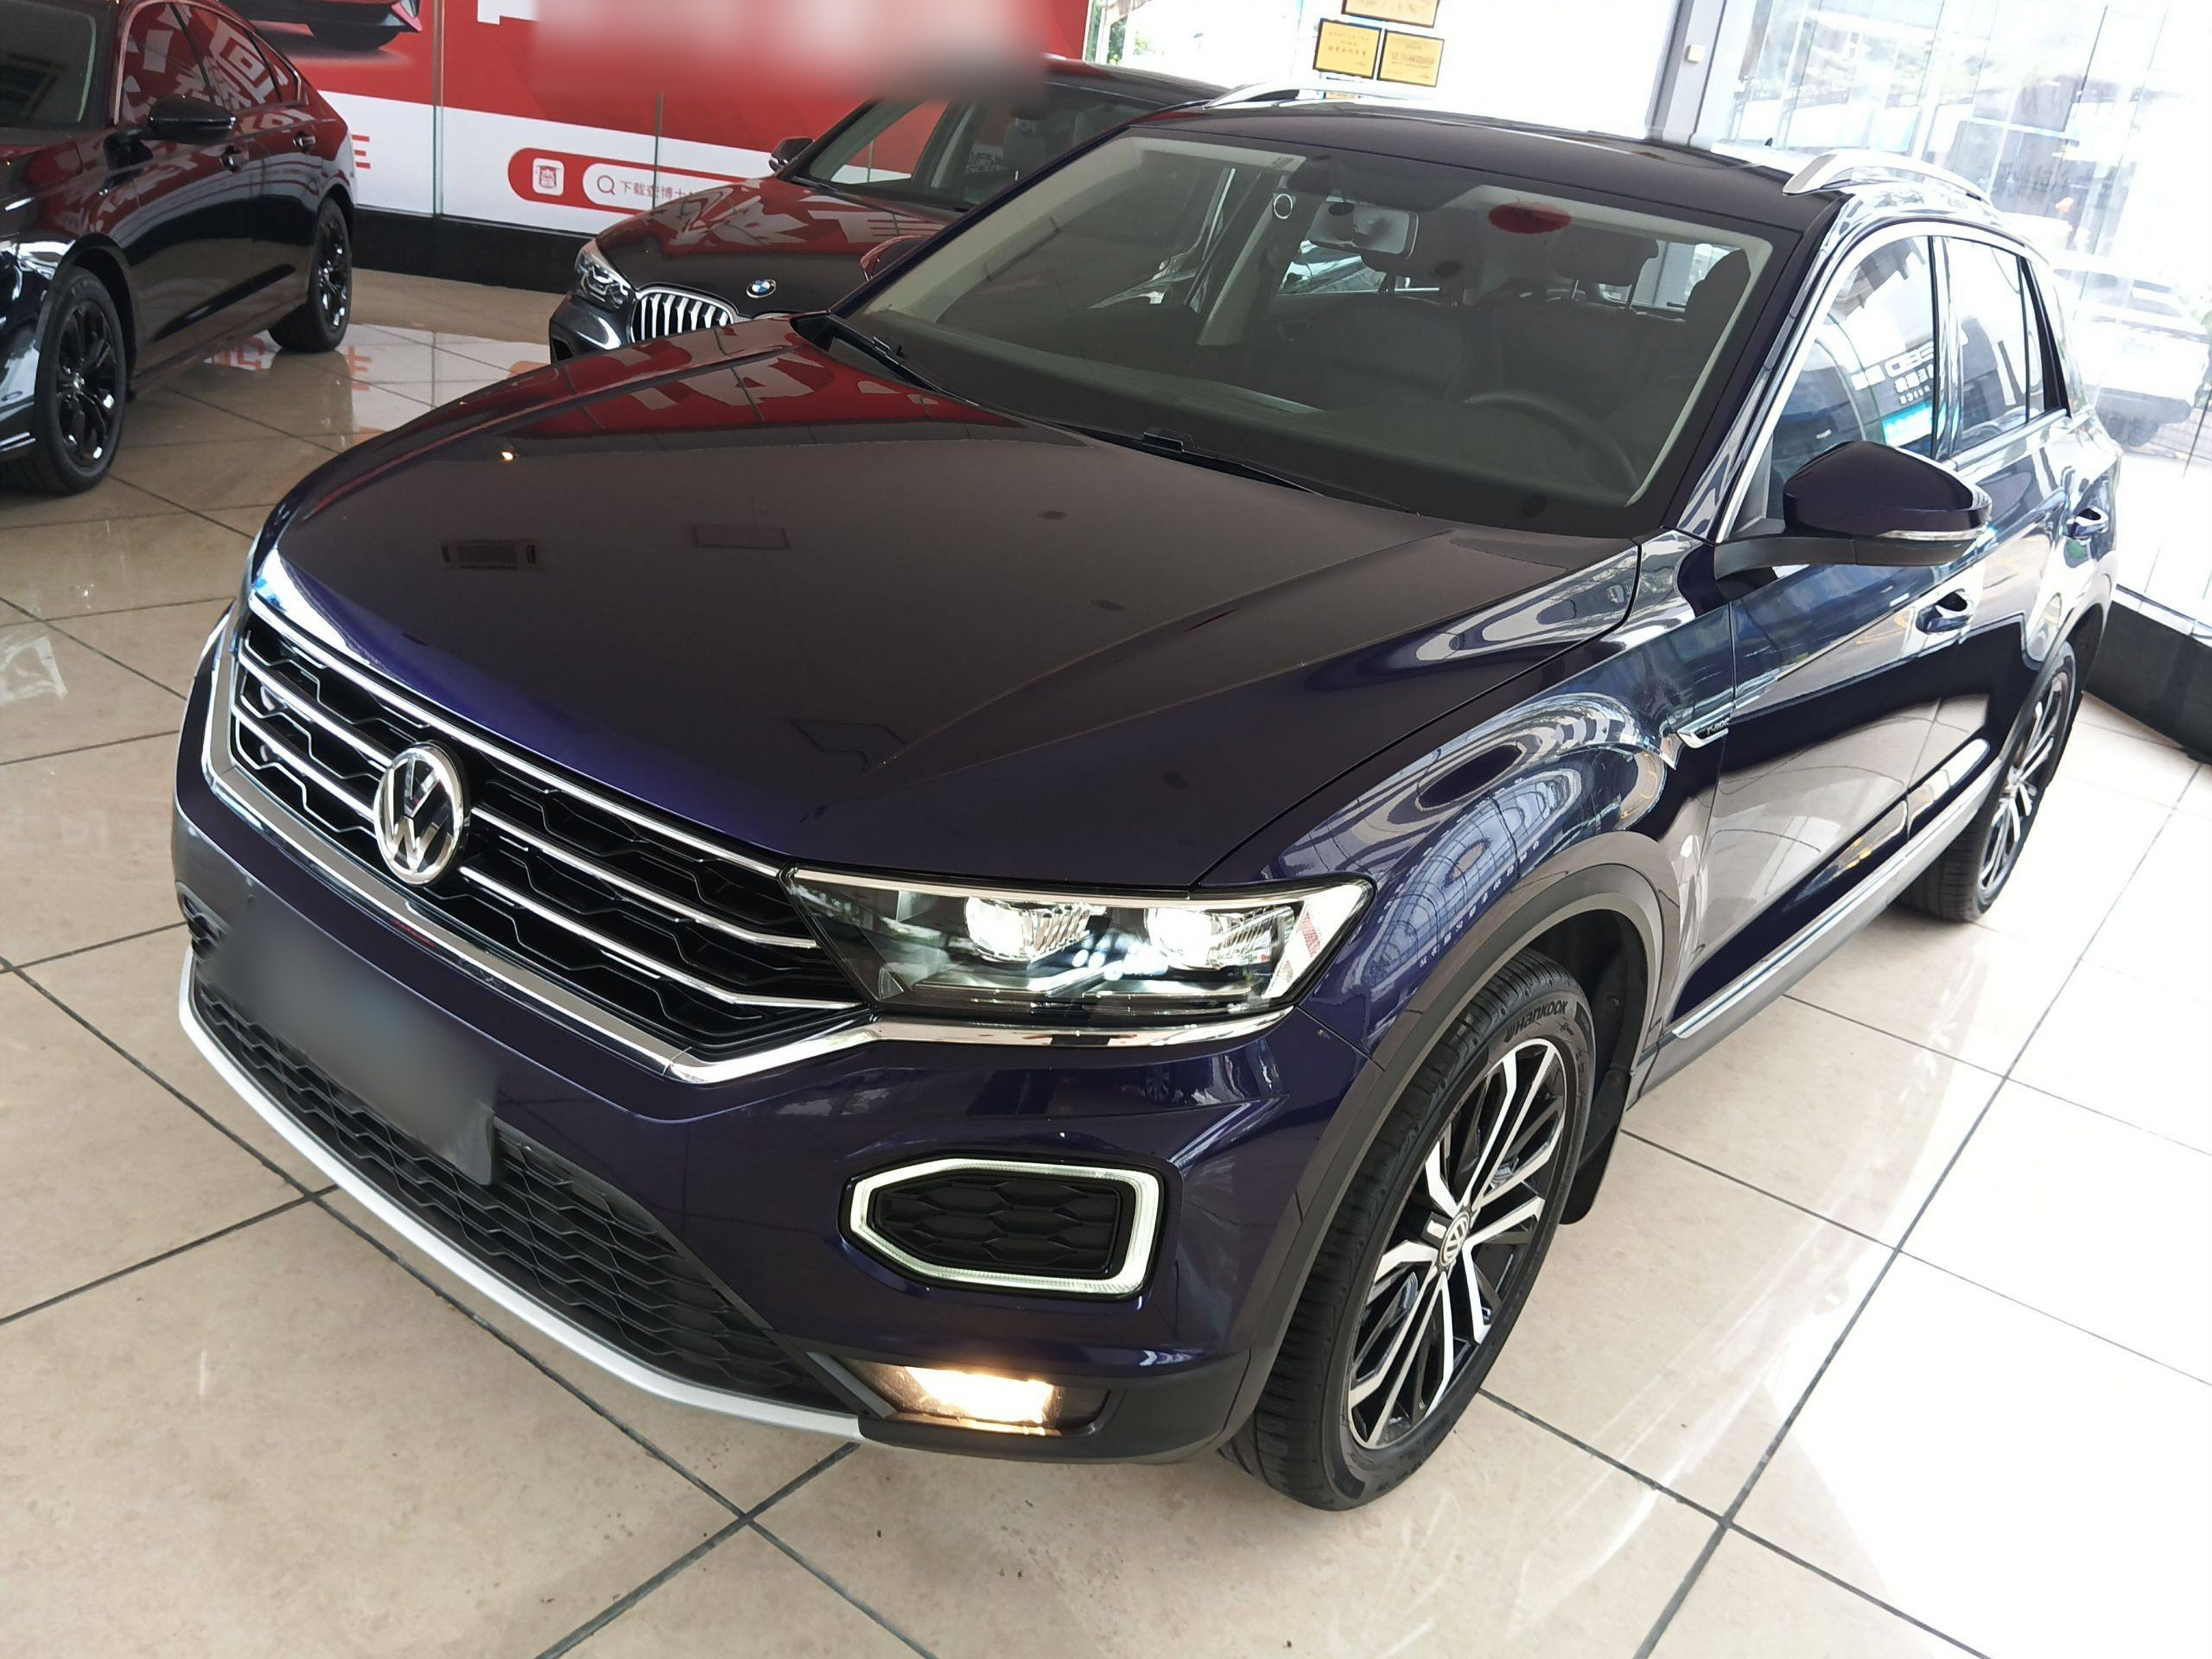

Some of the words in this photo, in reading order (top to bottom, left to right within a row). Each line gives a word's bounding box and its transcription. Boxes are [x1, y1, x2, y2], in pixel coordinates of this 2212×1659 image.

[620, 180, 692, 200] 下载查博士
